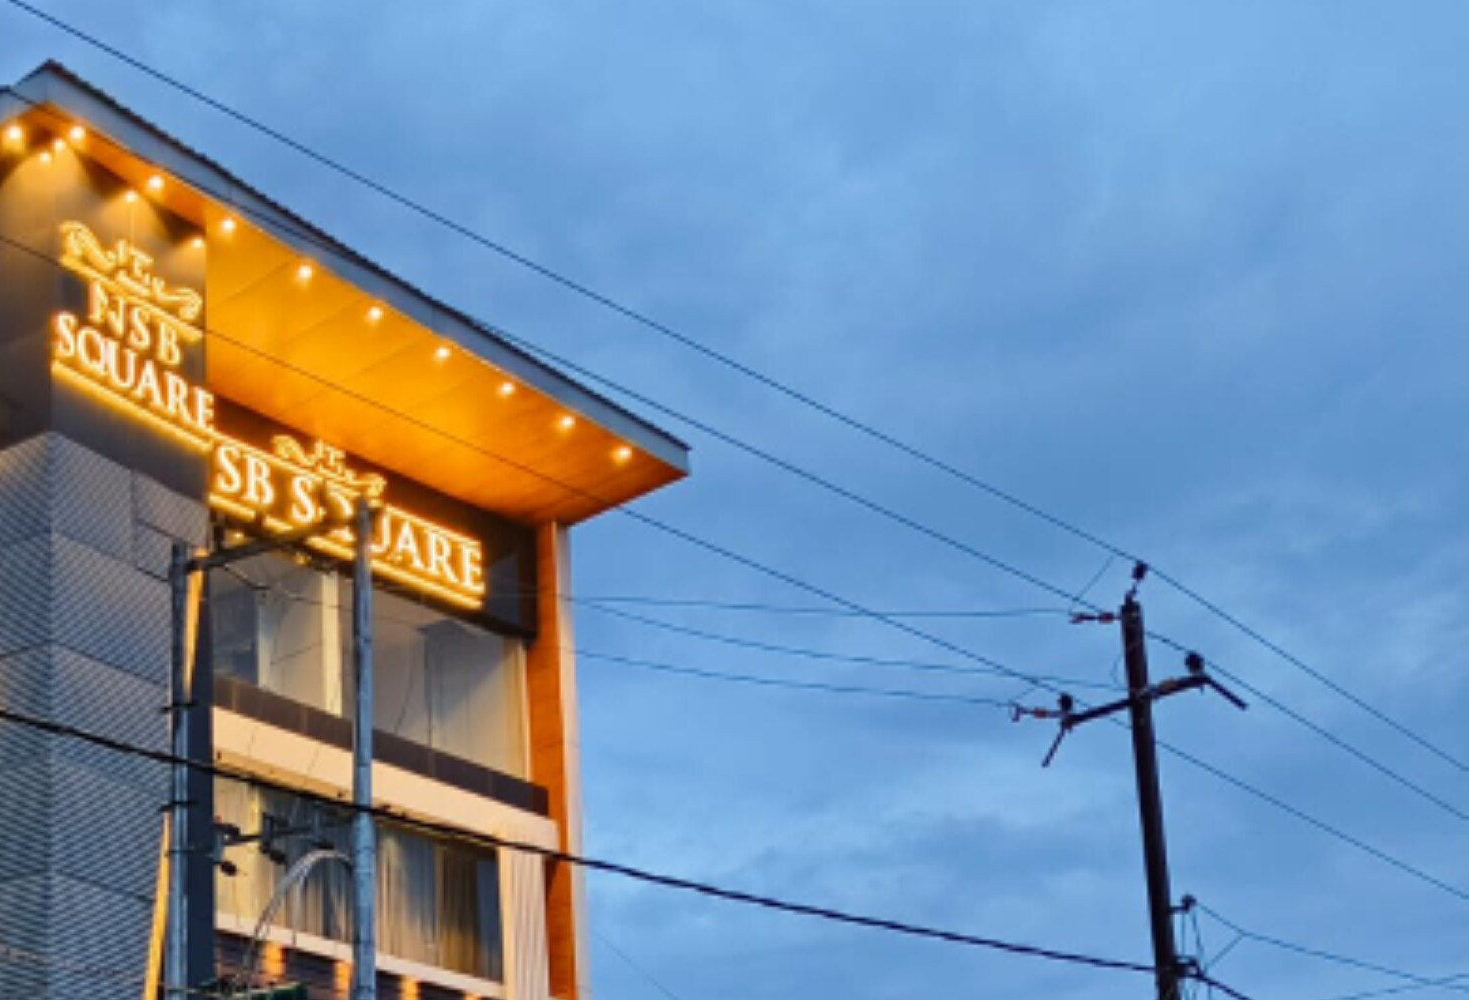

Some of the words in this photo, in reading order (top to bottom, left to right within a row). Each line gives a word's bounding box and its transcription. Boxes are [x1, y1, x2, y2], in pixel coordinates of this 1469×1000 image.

[90, 278, 181, 366] NSB
[52, 310, 215, 433] SQUARE
[216, 442, 274, 506] SB
